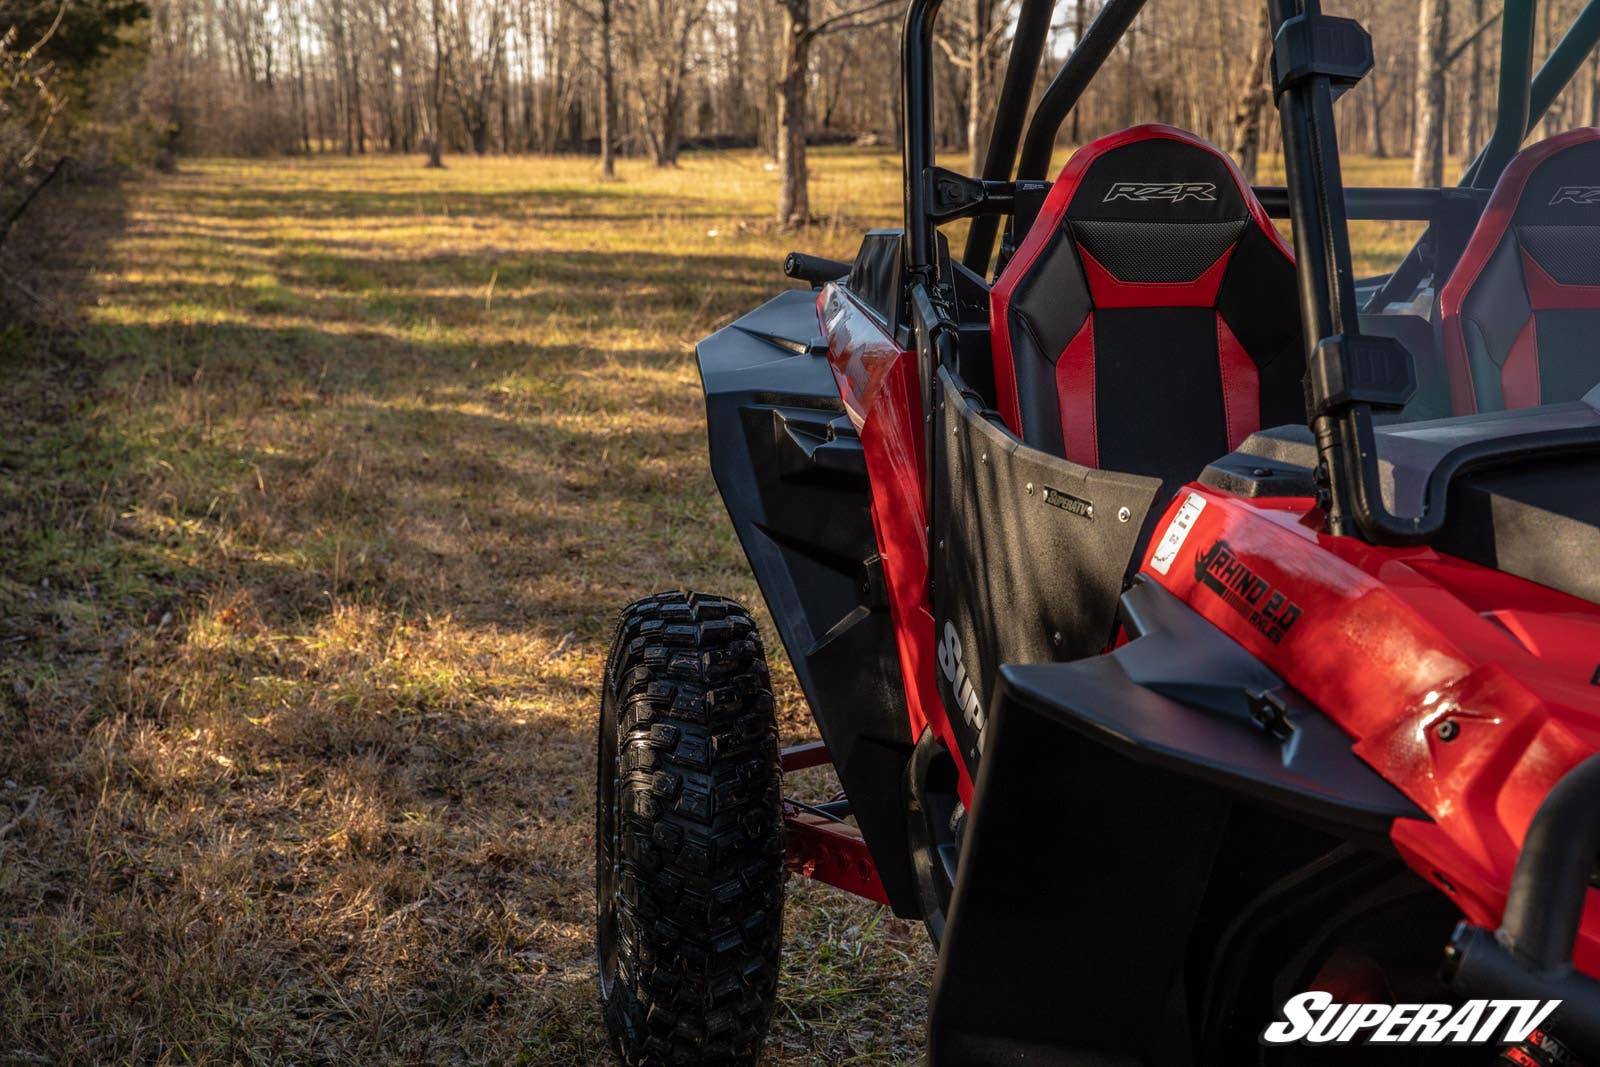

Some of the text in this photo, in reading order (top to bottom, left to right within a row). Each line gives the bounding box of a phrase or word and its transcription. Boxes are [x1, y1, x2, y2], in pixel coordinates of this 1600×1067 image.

[1102, 182, 1217, 203] RZR
[1208, 551, 1302, 632] RHINO 2.0
[1250, 611, 1284, 645] AXLES
